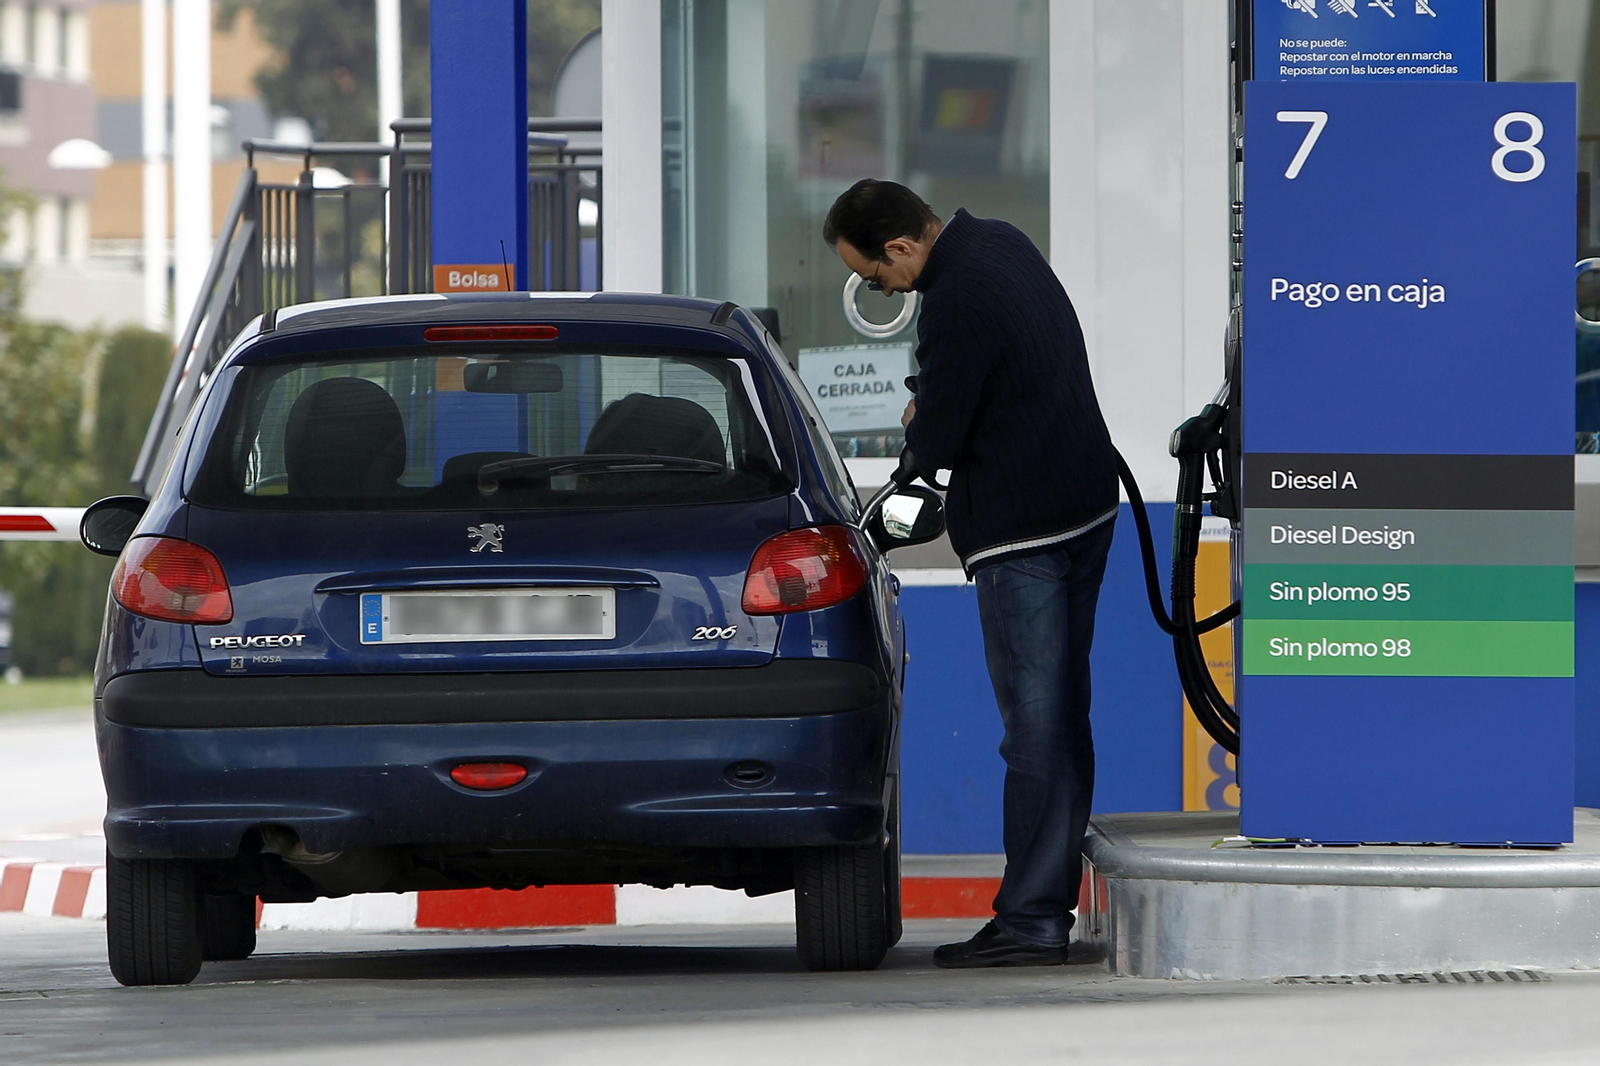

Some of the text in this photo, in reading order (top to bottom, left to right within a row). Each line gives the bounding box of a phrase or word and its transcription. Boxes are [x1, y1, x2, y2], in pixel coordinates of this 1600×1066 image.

[1280, 37, 1347, 50] No se puede:
[1280, 52, 1328, 64] Repostar
[1329, 53, 1349, 61] con
[1351, 51, 1360, 61] el
[1362, 51, 1395, 61] motor
[1412, 50, 1452, 60] marcha
[1280, 64, 1458, 77] Repostar con las luces encendidas
[1276, 111, 1328, 180] 7
[1491, 111, 1546, 182] 8
[449, 270, 499, 288] Bolsa
[1271, 278, 1446, 309] Pago en caja
[834, 363, 876, 377] CAJA
[818, 380, 895, 398] CERRADA
[1271, 471, 1358, 490] Diesel A
[1270, 525, 1415, 550] Diesel Design
[1269, 582, 1411, 605] Sin plomo 95
[368, 623, 377, 633] E
[692, 625, 738, 640] 206
[210, 634, 306, 649] PEUGEOT
[1269, 637, 1411, 660] Sin plomo 98
